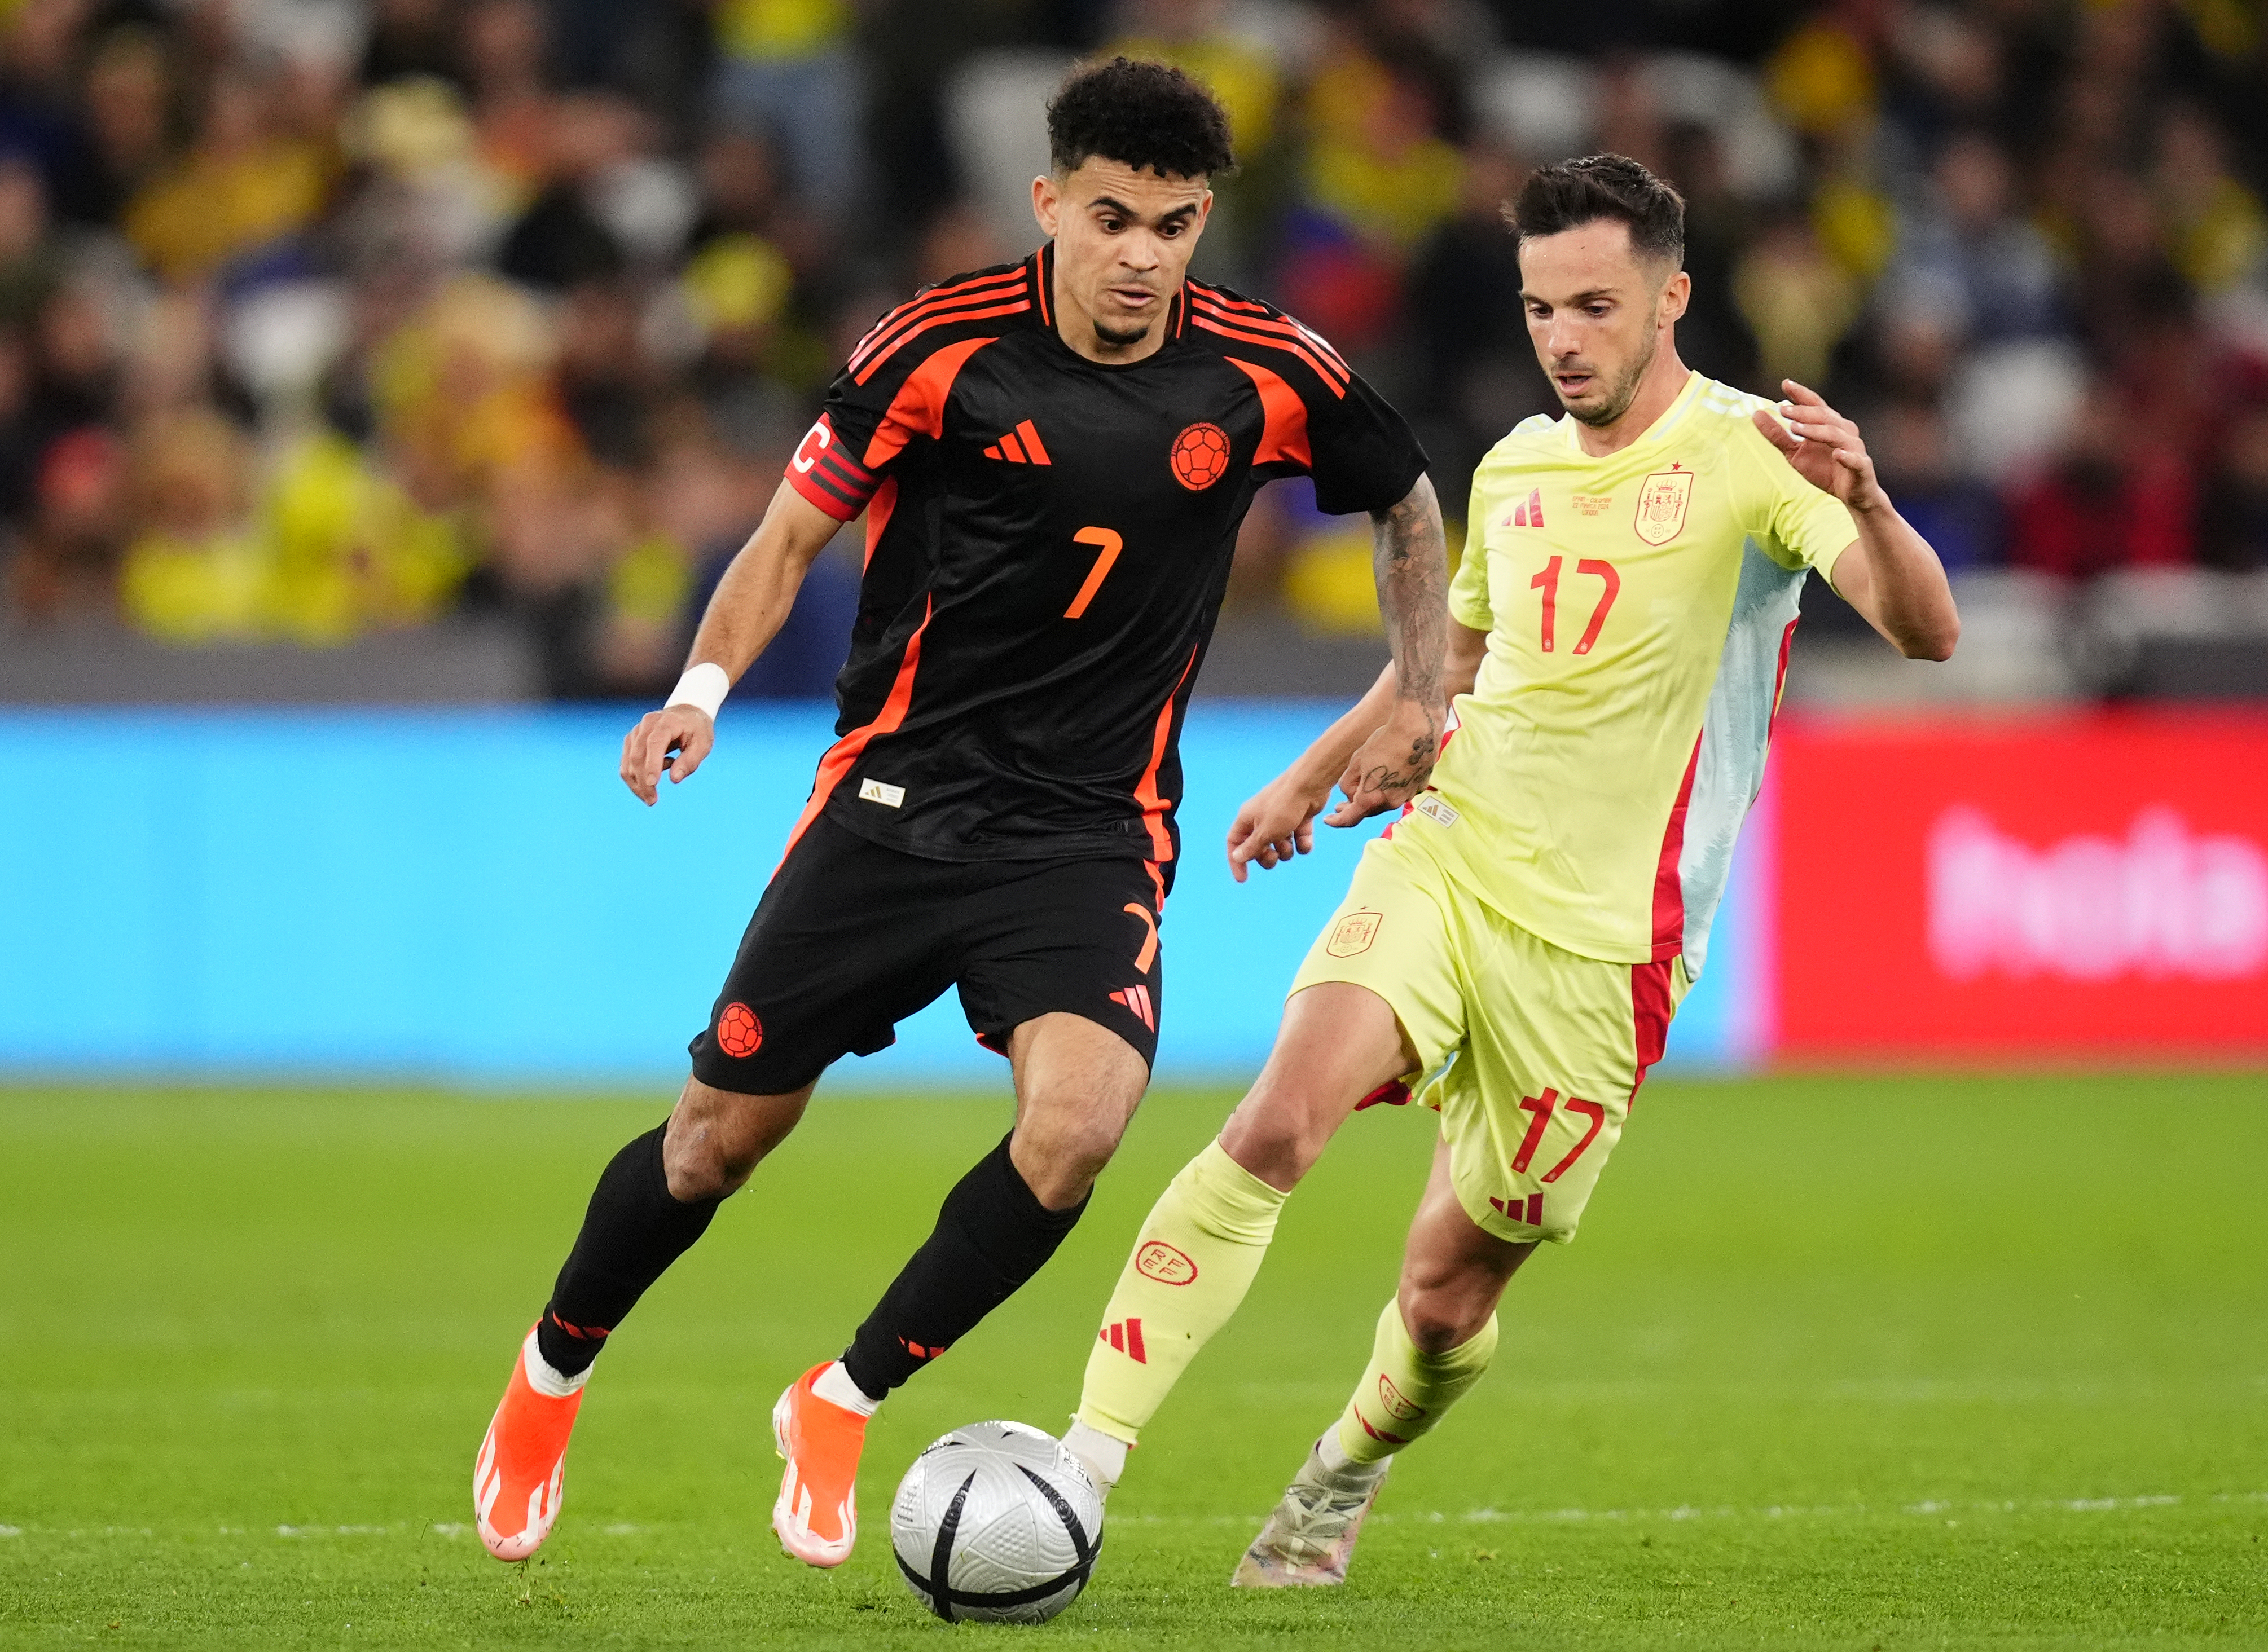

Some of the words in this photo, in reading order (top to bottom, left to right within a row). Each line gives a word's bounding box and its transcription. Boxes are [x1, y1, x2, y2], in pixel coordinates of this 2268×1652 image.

[793, 422, 830, 473] C
[1063, 526, 1123, 619] 7
[1530, 556, 1620, 654] 17
[1123, 902, 1157, 975] 7
[1511, 1087, 1605, 1183] 17
